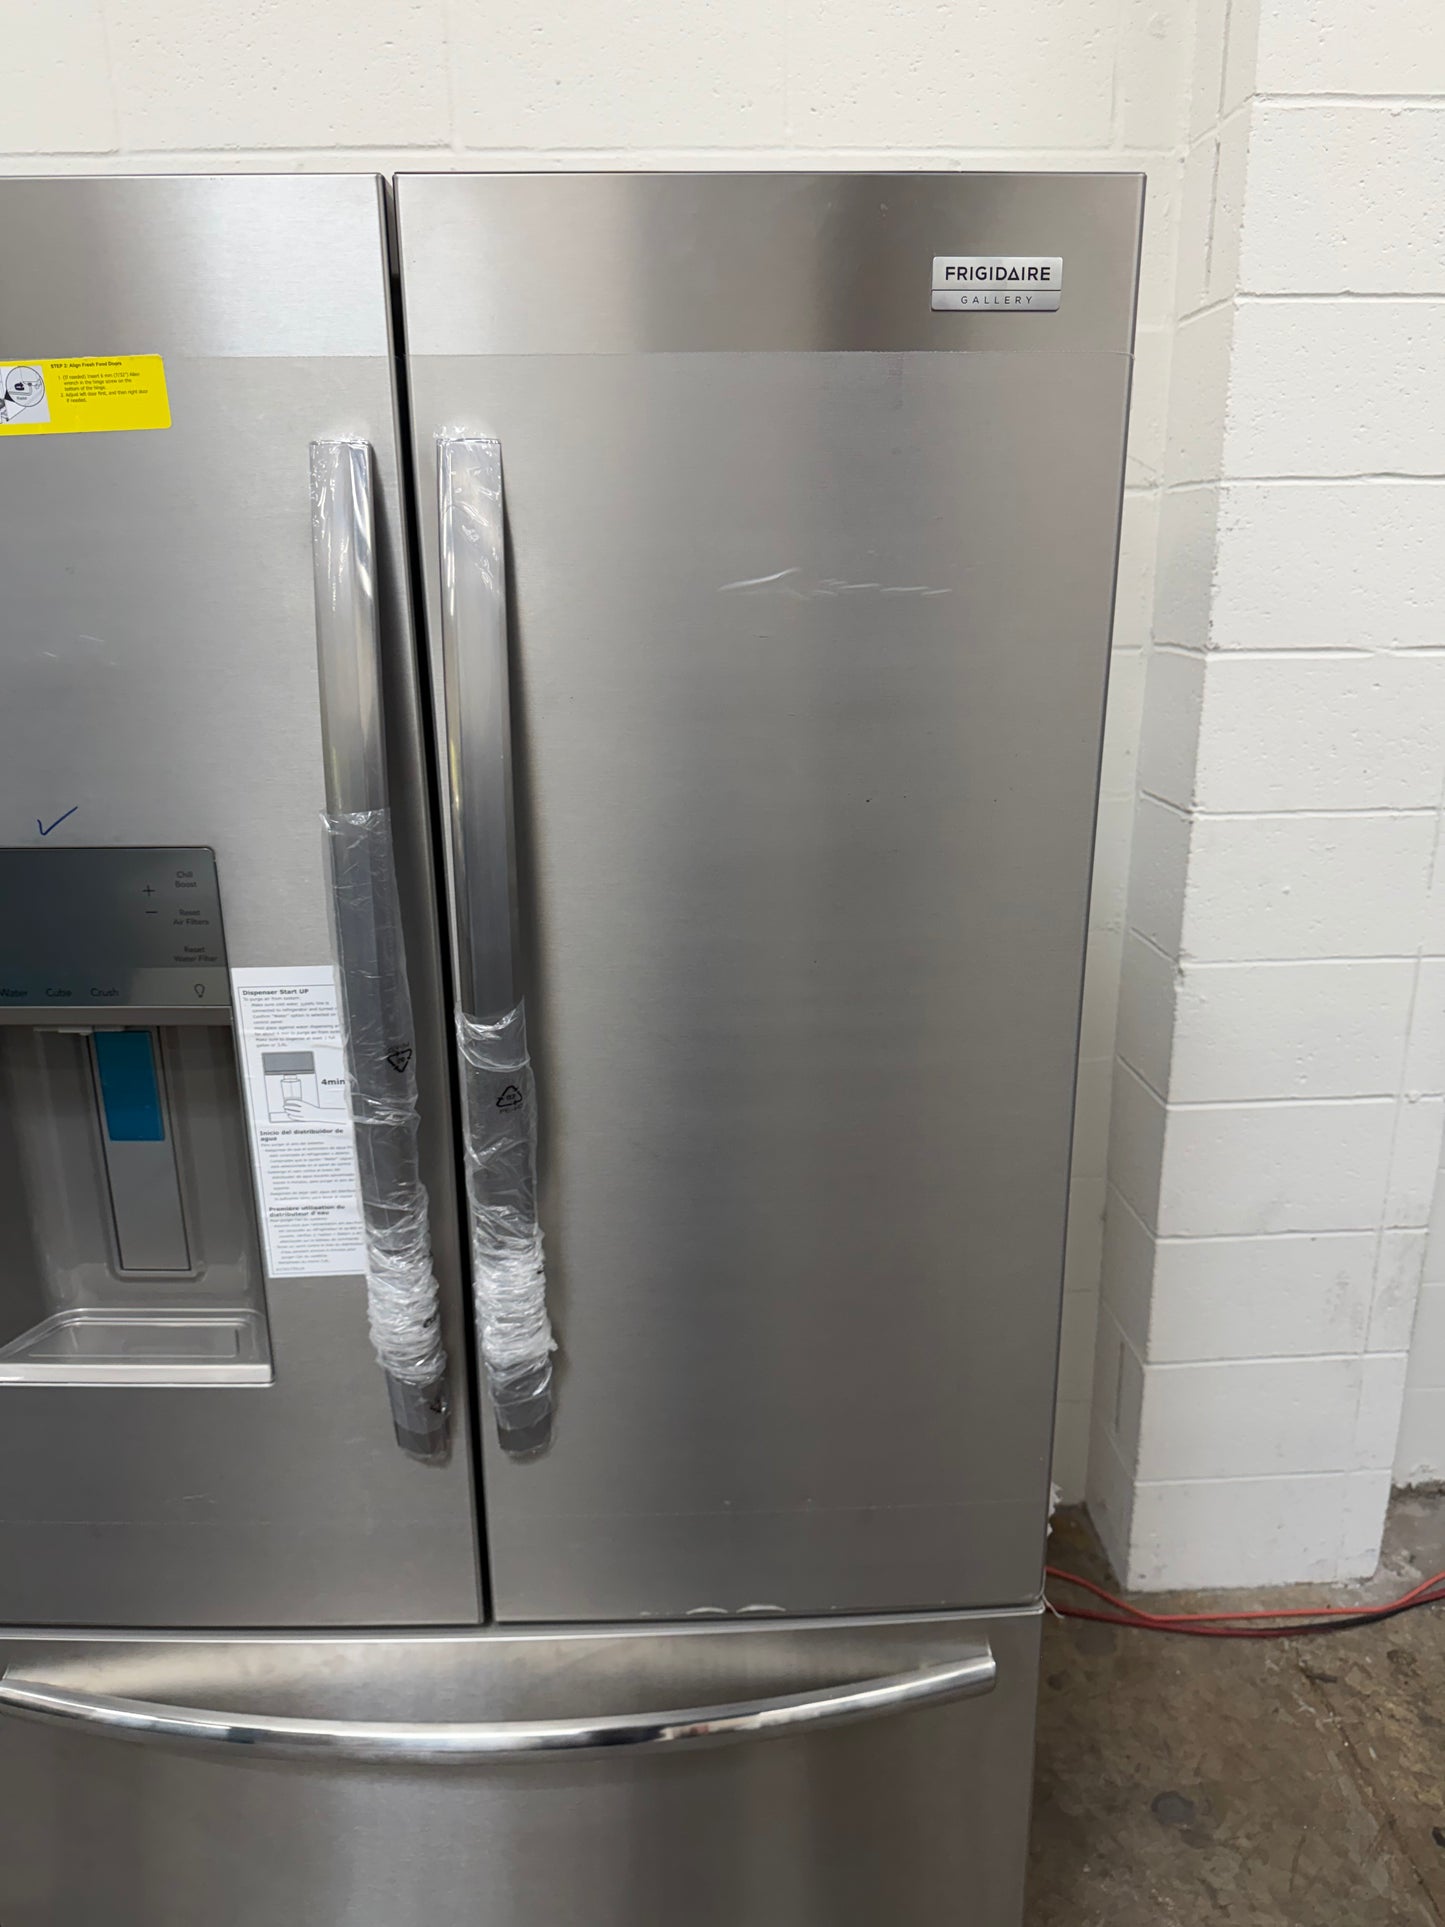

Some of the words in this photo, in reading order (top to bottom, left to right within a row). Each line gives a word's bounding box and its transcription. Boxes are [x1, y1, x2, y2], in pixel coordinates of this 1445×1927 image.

[945, 266, 1051, 281] FRIGIDAIRE
[960, 296, 1032, 304] GALLERY
[176, 870, 193, 878] Chill
[46, 988, 72, 997] Cube
[90, 988, 120, 997] Crush
